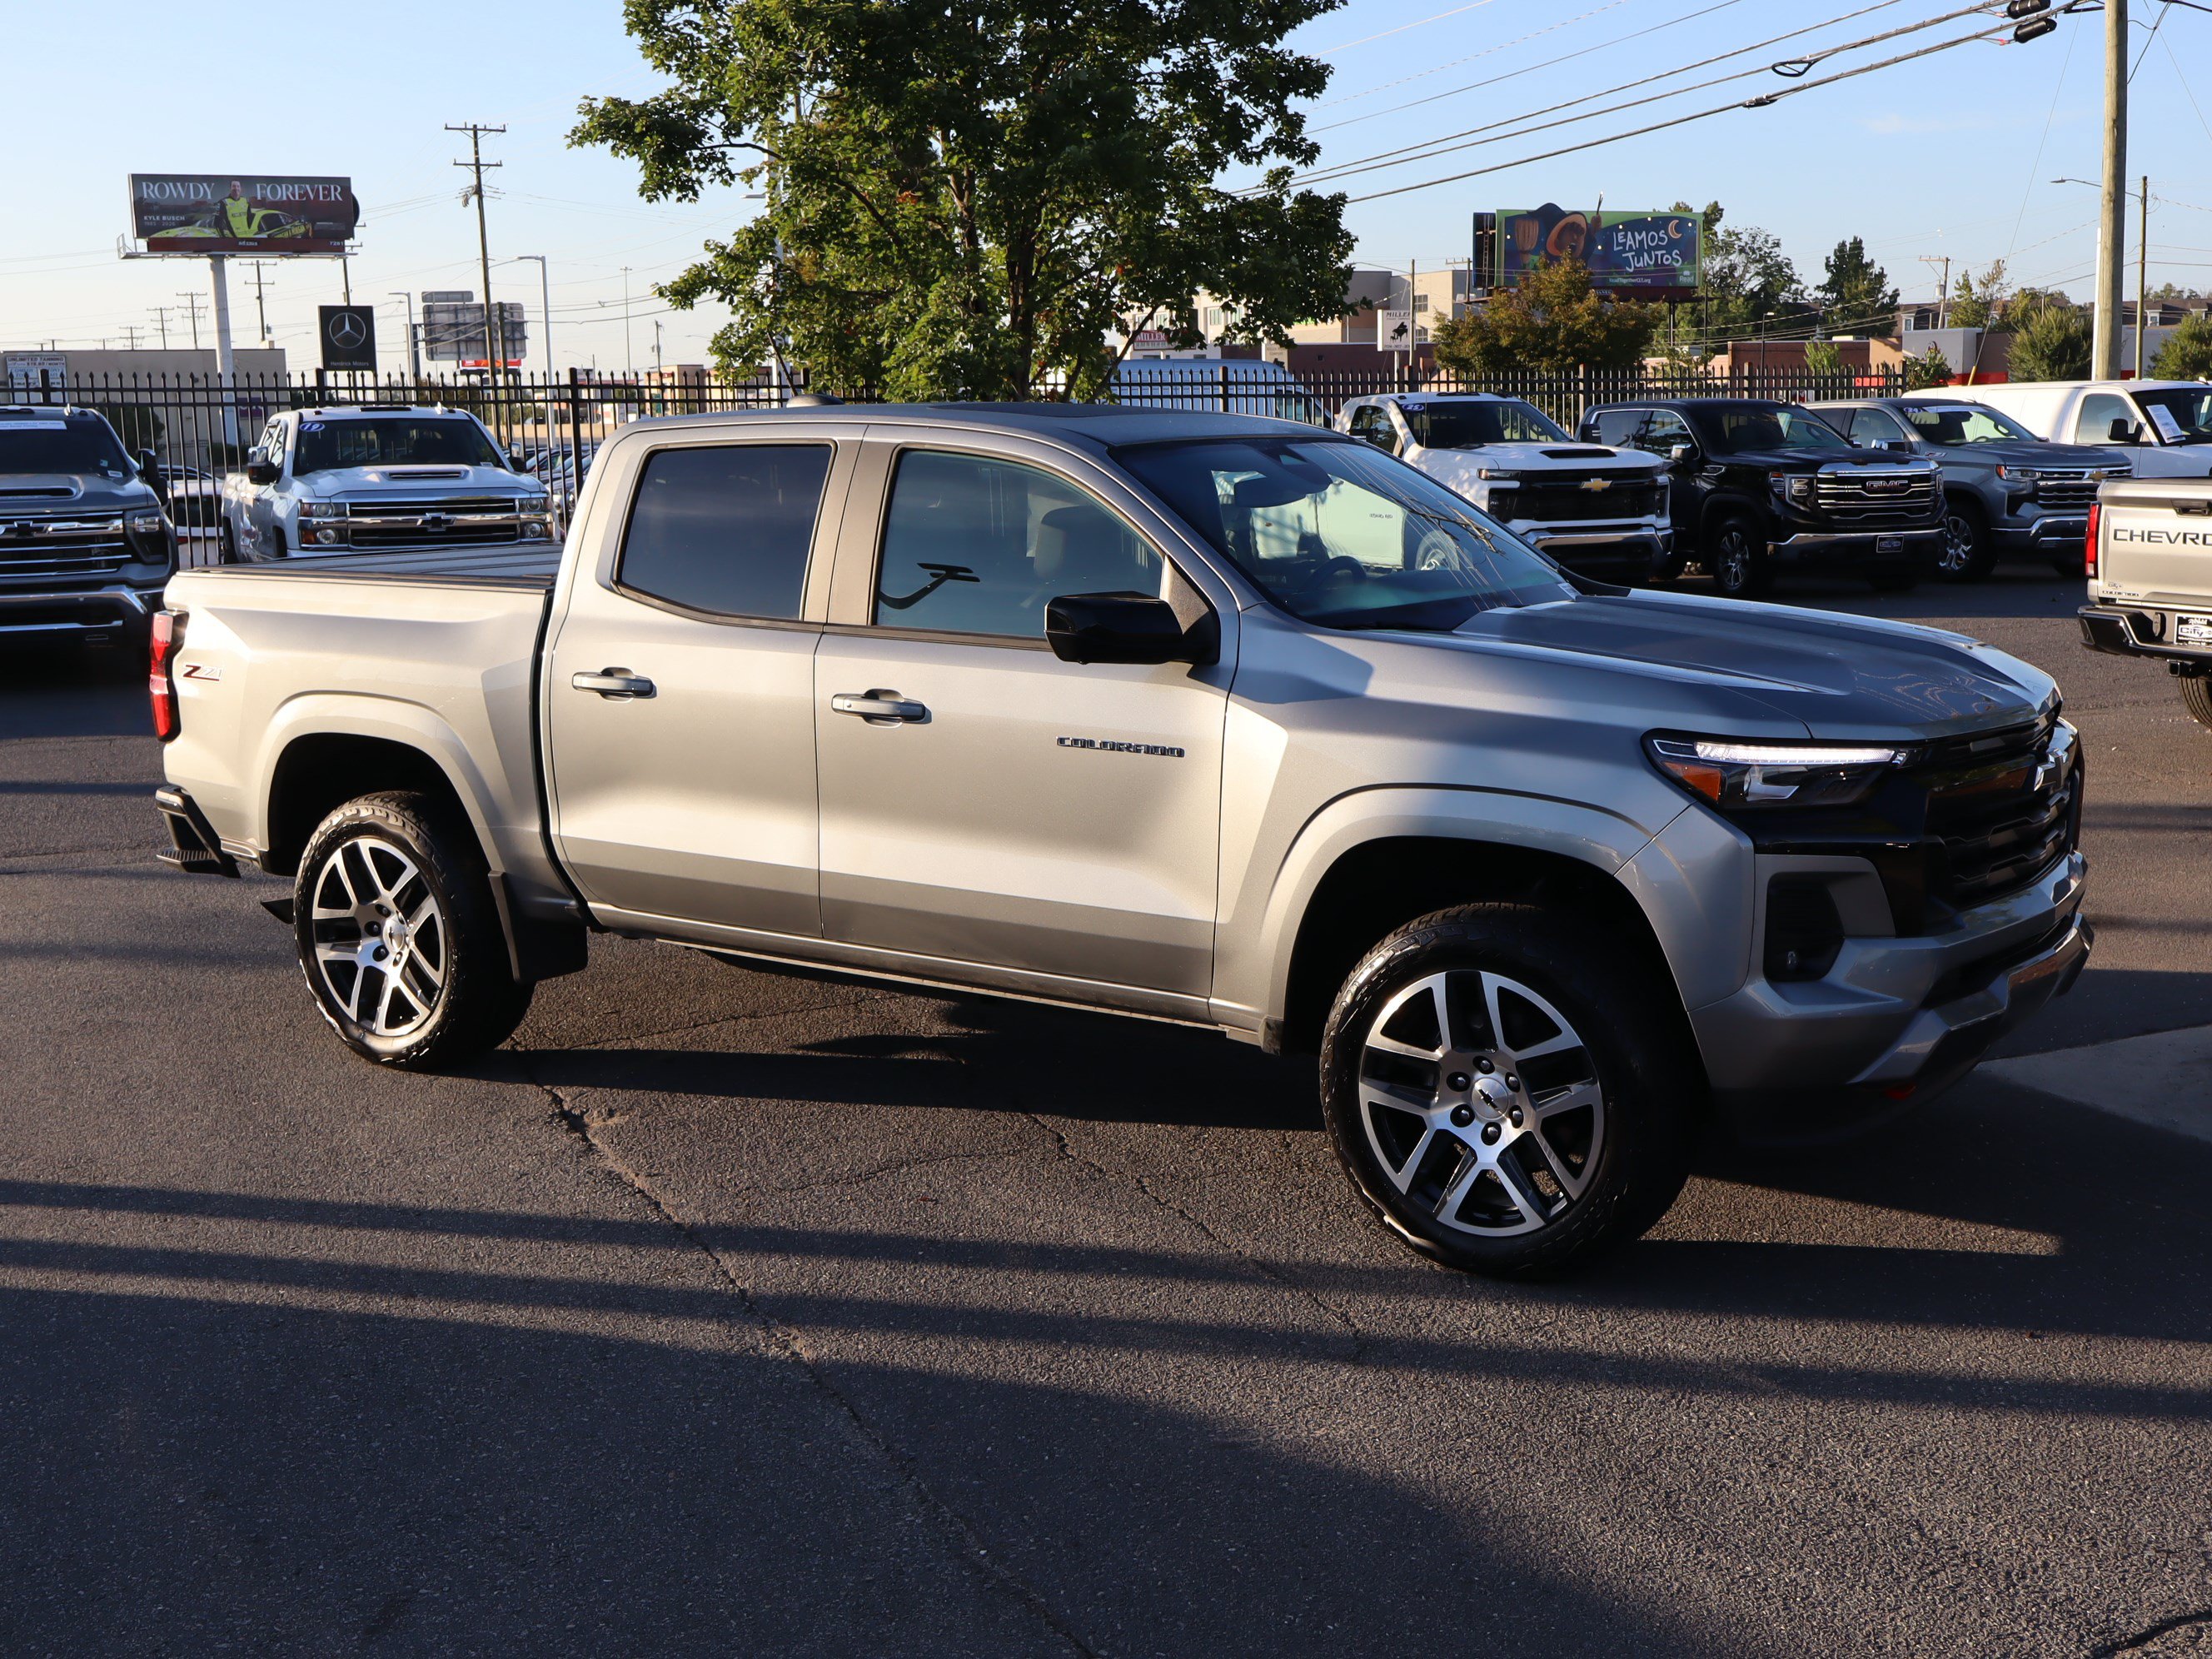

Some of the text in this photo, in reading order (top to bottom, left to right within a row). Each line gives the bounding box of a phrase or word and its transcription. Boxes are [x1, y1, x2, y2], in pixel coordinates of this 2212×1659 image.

[142, 182, 343, 202] ROWDY FOREVER
[1613, 230, 1668, 252] LEAMOS
[1679, 275, 1694, 283] Read
[1136, 331, 1167, 341] MILLER
[303, 421, 321, 431] 19
[1866, 481, 1908, 491] GMC
[2180, 627, 2205, 637] City
[1056, 736, 1185, 758] COLORADO
